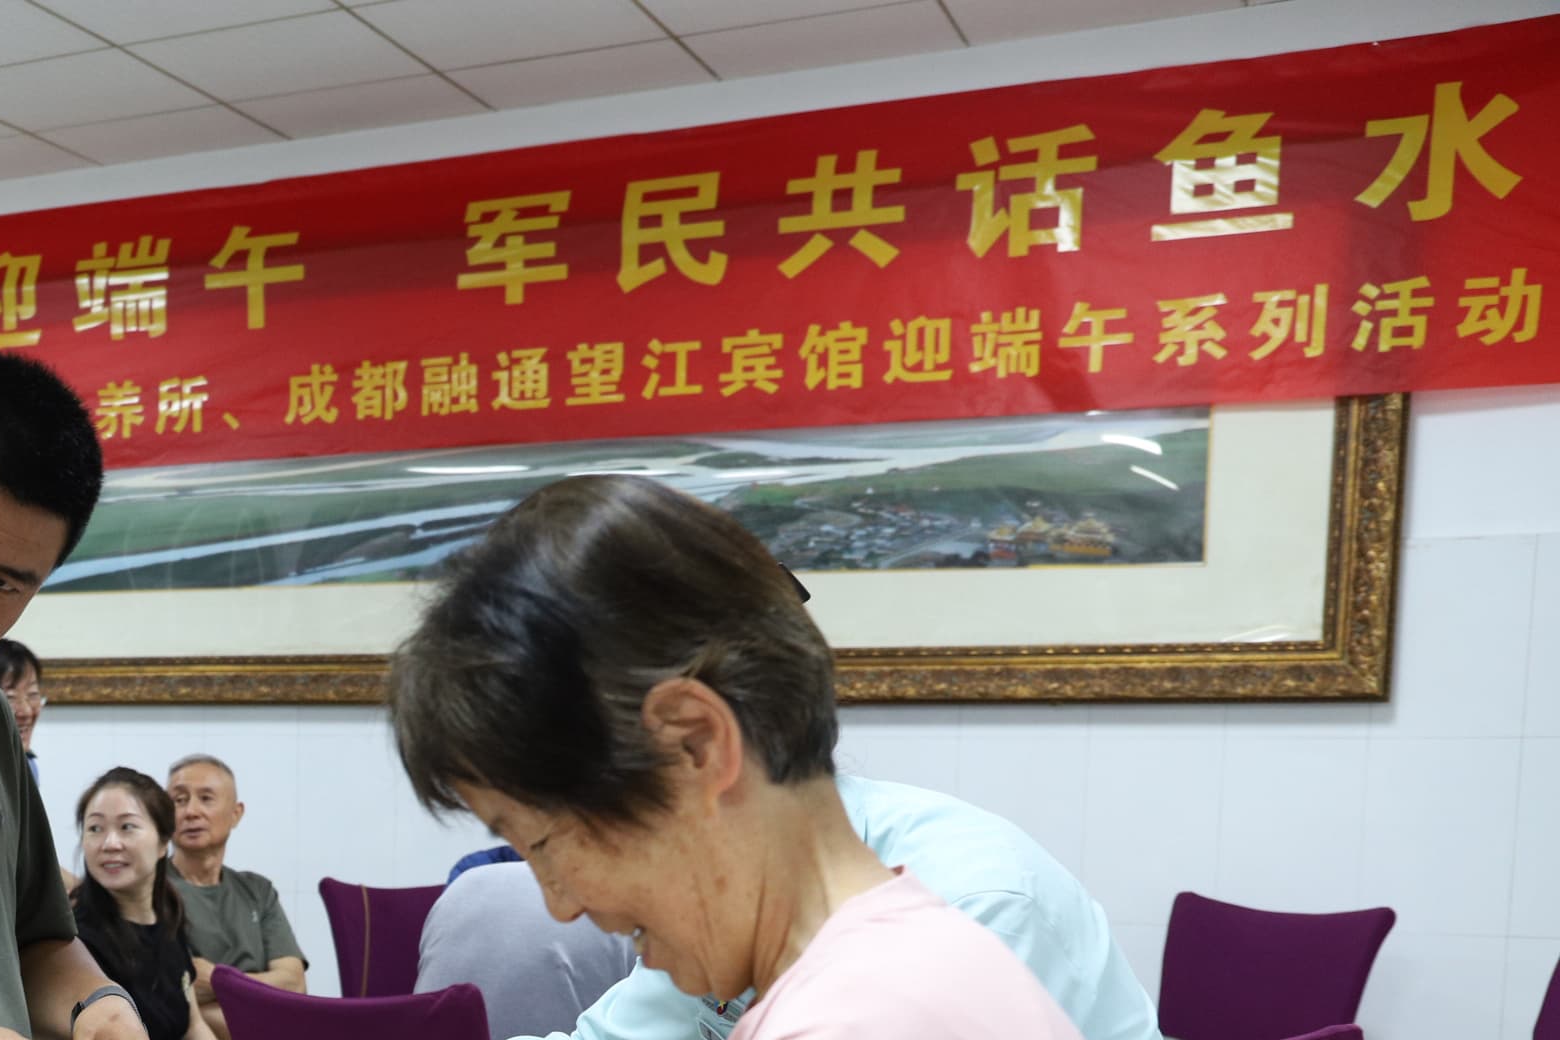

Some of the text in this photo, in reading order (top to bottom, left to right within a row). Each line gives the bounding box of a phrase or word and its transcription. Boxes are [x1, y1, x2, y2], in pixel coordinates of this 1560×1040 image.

[456, 82, 1523, 305] 军民共话鱼水
